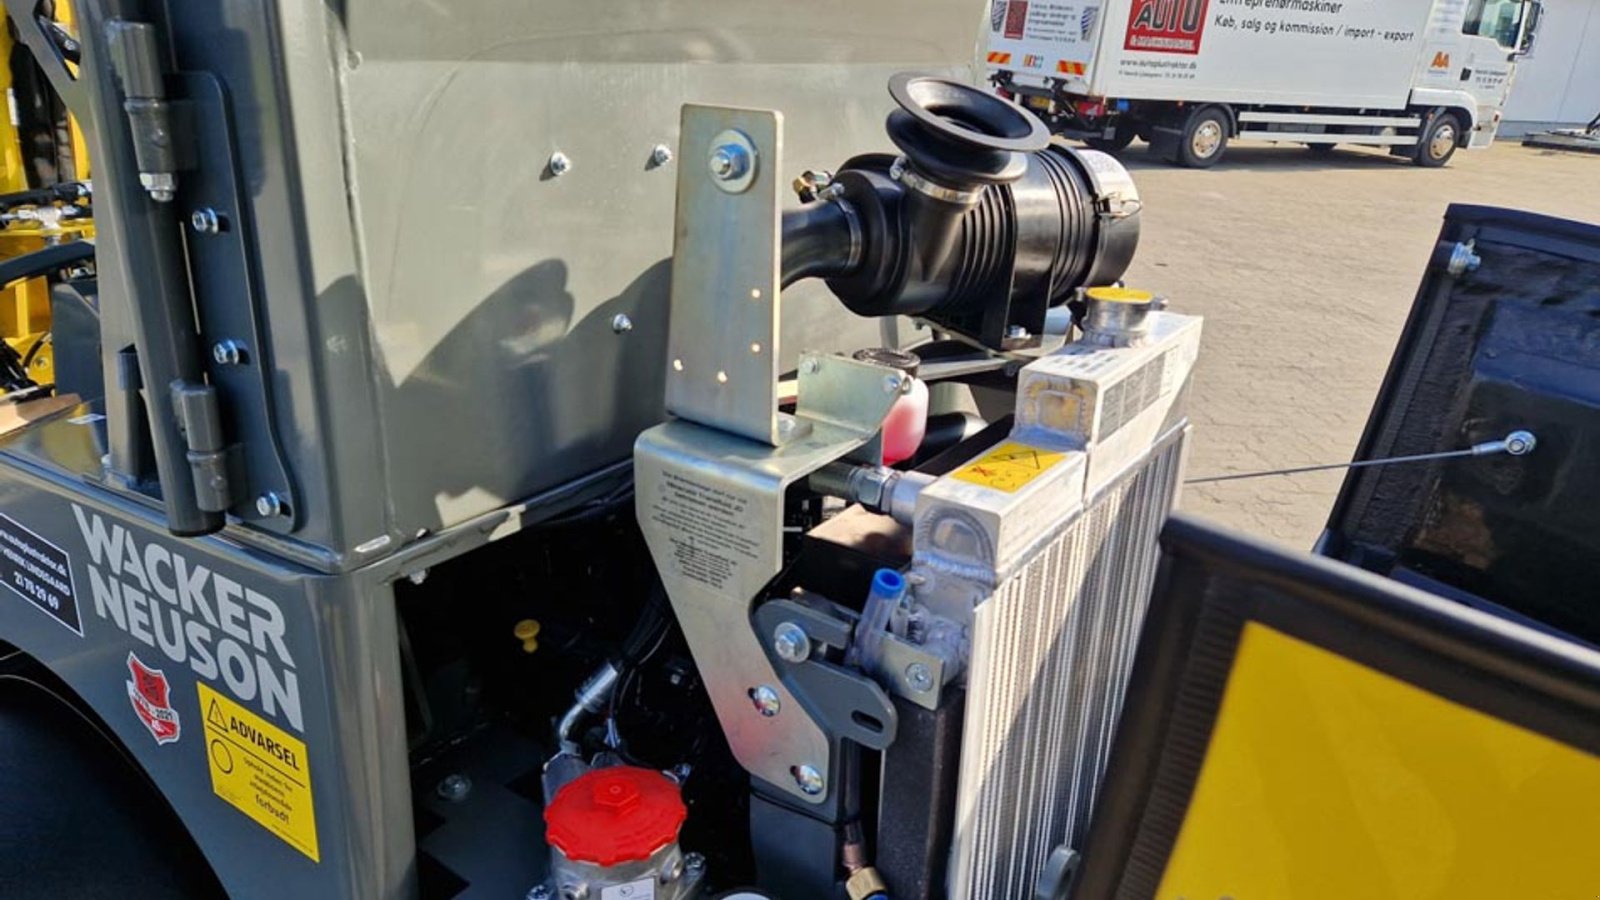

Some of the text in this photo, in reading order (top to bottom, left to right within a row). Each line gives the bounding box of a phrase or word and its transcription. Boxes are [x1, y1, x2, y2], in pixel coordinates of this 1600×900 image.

[1241, 18, 1261, 33] salg
[1264, 21, 1277, 34] og
[1279, 20, 1334, 36] kommission
[1344, 26, 1375, 40] import
[1384, 31, 1414, 42] export
[71, 502, 297, 669] WACKER
[87, 564, 304, 733] NEUSON
[230, 716, 300, 771] ADVARSEL
